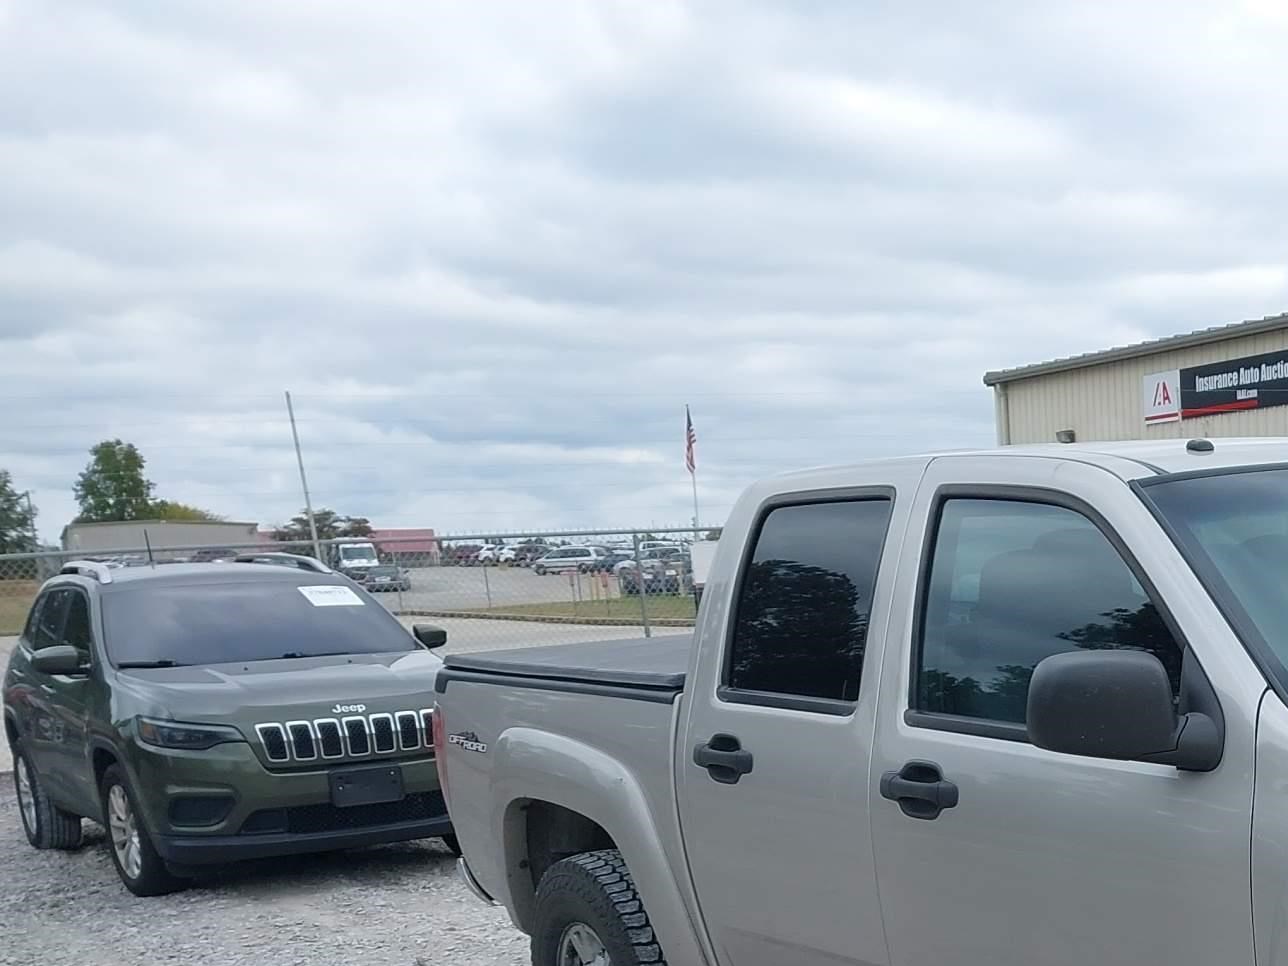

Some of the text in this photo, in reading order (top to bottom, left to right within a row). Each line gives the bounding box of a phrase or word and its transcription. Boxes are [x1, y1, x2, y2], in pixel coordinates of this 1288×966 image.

[1195, 371, 1238, 393] Insurance
[1239, 367, 1259, 385] Auto
[332, 704, 366, 713] Jeep
